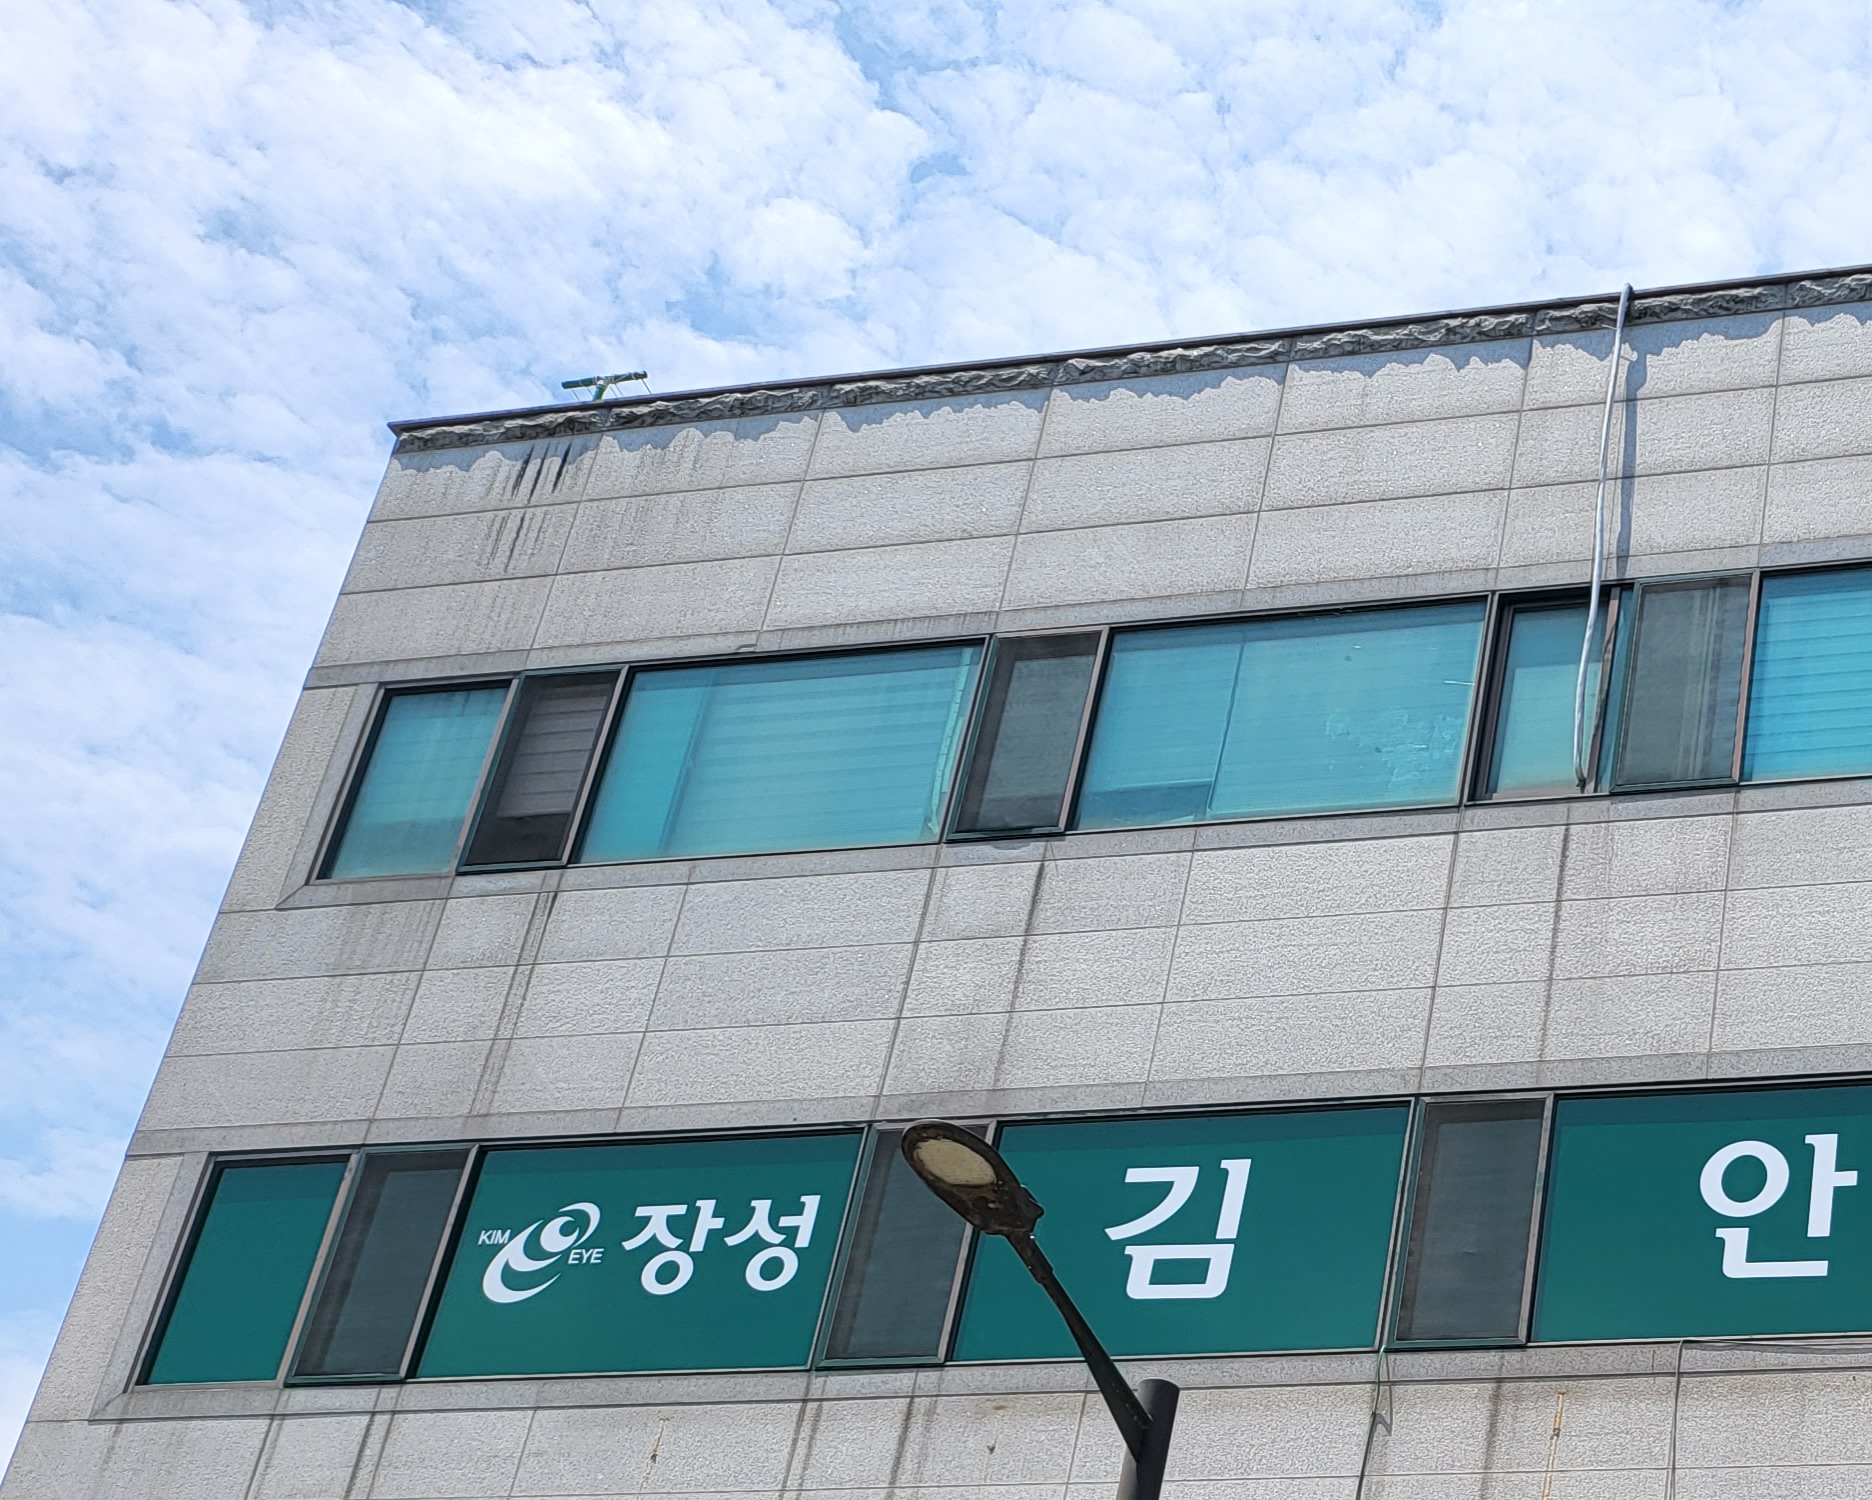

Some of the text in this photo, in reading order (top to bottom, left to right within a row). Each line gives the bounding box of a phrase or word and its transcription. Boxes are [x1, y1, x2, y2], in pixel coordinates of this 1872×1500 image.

[478, 1229, 603, 1264] KIM EYE
[622, 1195, 821, 1295] 장성
[1105, 1159, 1252, 1300] 김
[1700, 1133, 1858, 1279] 안
